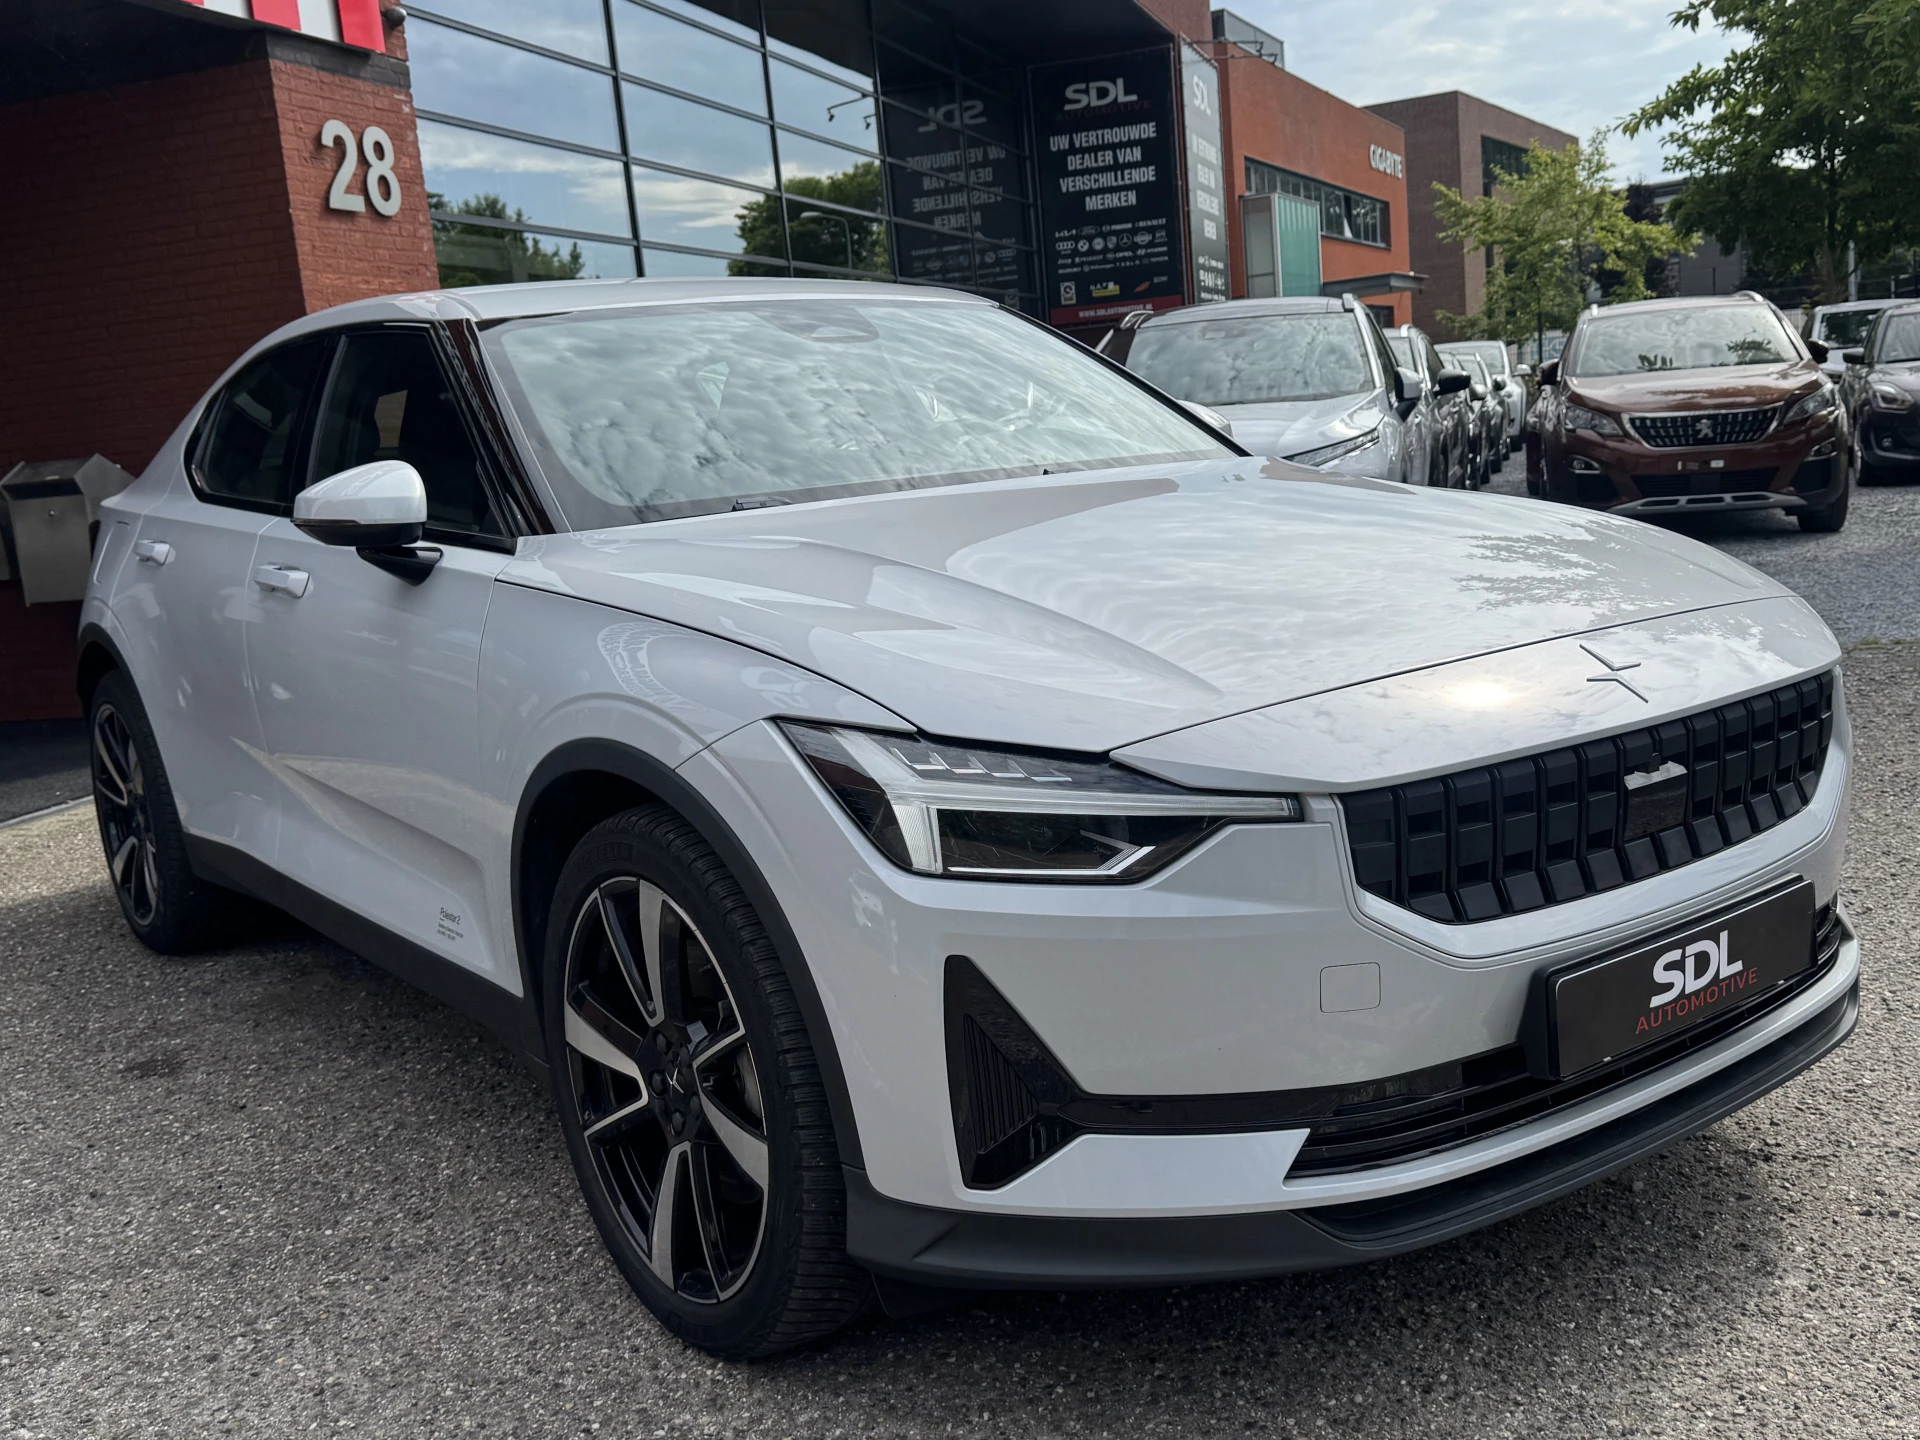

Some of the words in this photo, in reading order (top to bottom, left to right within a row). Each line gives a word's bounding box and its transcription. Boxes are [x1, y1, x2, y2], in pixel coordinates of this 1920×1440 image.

[1064, 77, 1138, 110] SDL
[1049, 134, 1070, 152] UW
[1072, 121, 1157, 149] VERTROUWDE
[321, 119, 402, 216] 28
[1067, 150, 1114, 171] DEALER
[1116, 145, 1142, 164] VAN
[1369, 143, 1402, 179] GIGABYTE
[1059, 165, 1156, 193] VERSCHILLENDE
[1085, 189, 1137, 211] MERKEN
[1649, 929, 1744, 1009] SDL
[1635, 966, 1759, 1035] AUTOMOTIVE
